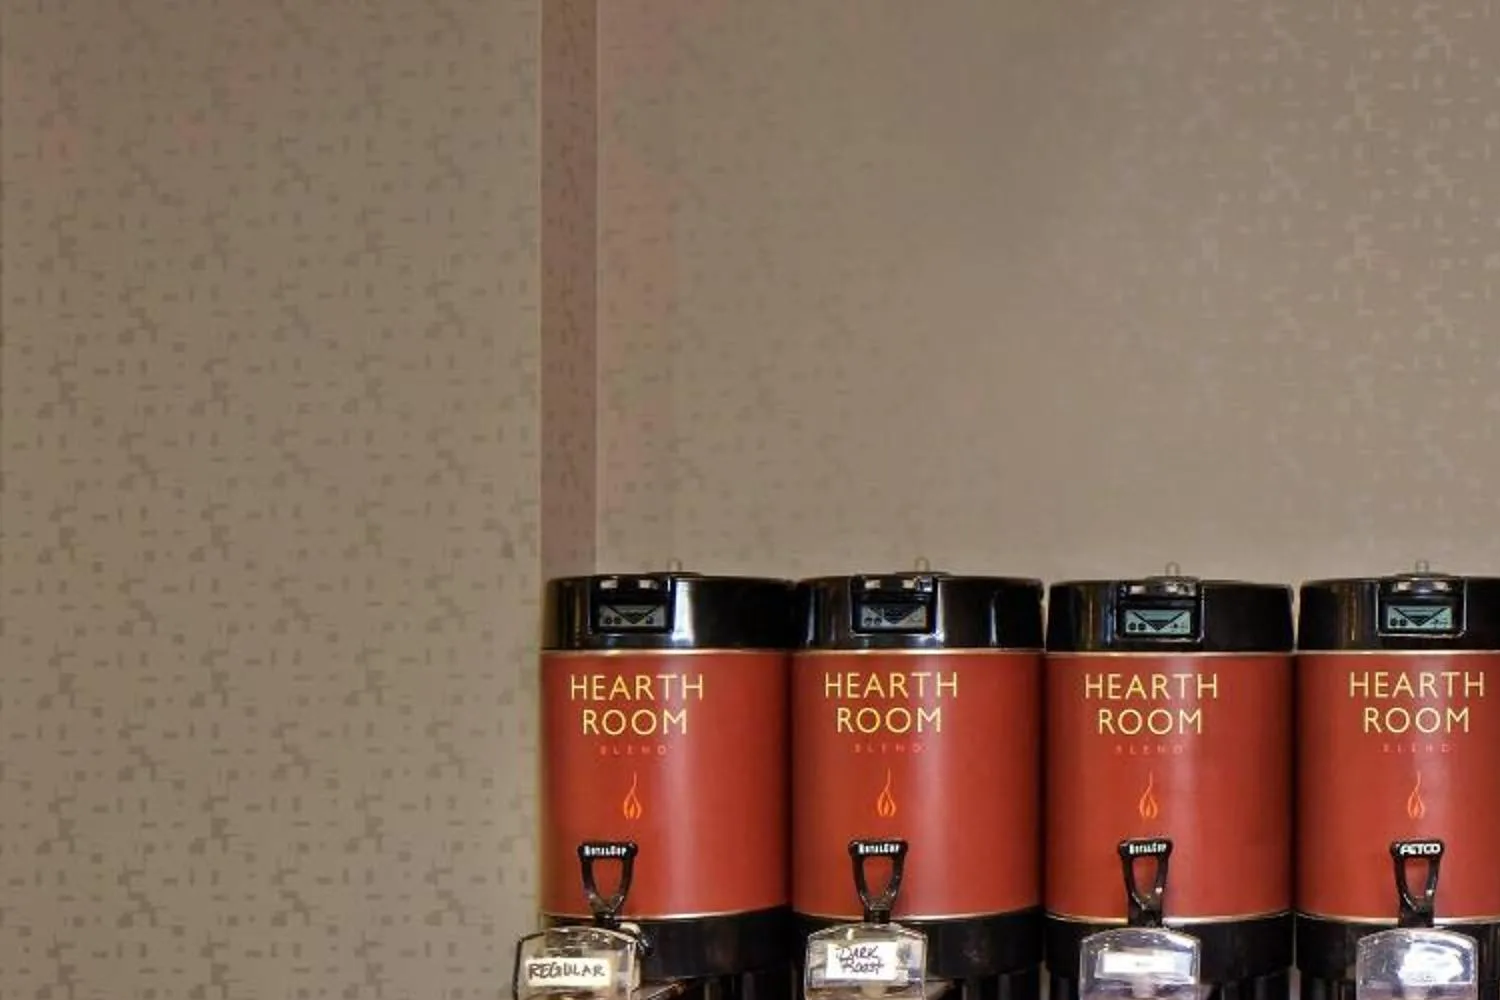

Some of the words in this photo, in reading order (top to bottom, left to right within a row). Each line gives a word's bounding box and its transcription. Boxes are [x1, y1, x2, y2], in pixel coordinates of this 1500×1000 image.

[571, 673, 703, 701] HEARTH
[825, 671, 957, 699] HEARTH
[1085, 673, 1218, 700] HEARTH
[1350, 671, 1484, 699] HEARTH
[583, 709, 688, 735] ROOM
[837, 707, 942, 733] ROOM
[1098, 708, 1202, 735] ROOM
[1364, 707, 1470, 734] ROOM
[528, 962, 605, 979] REGULAR
